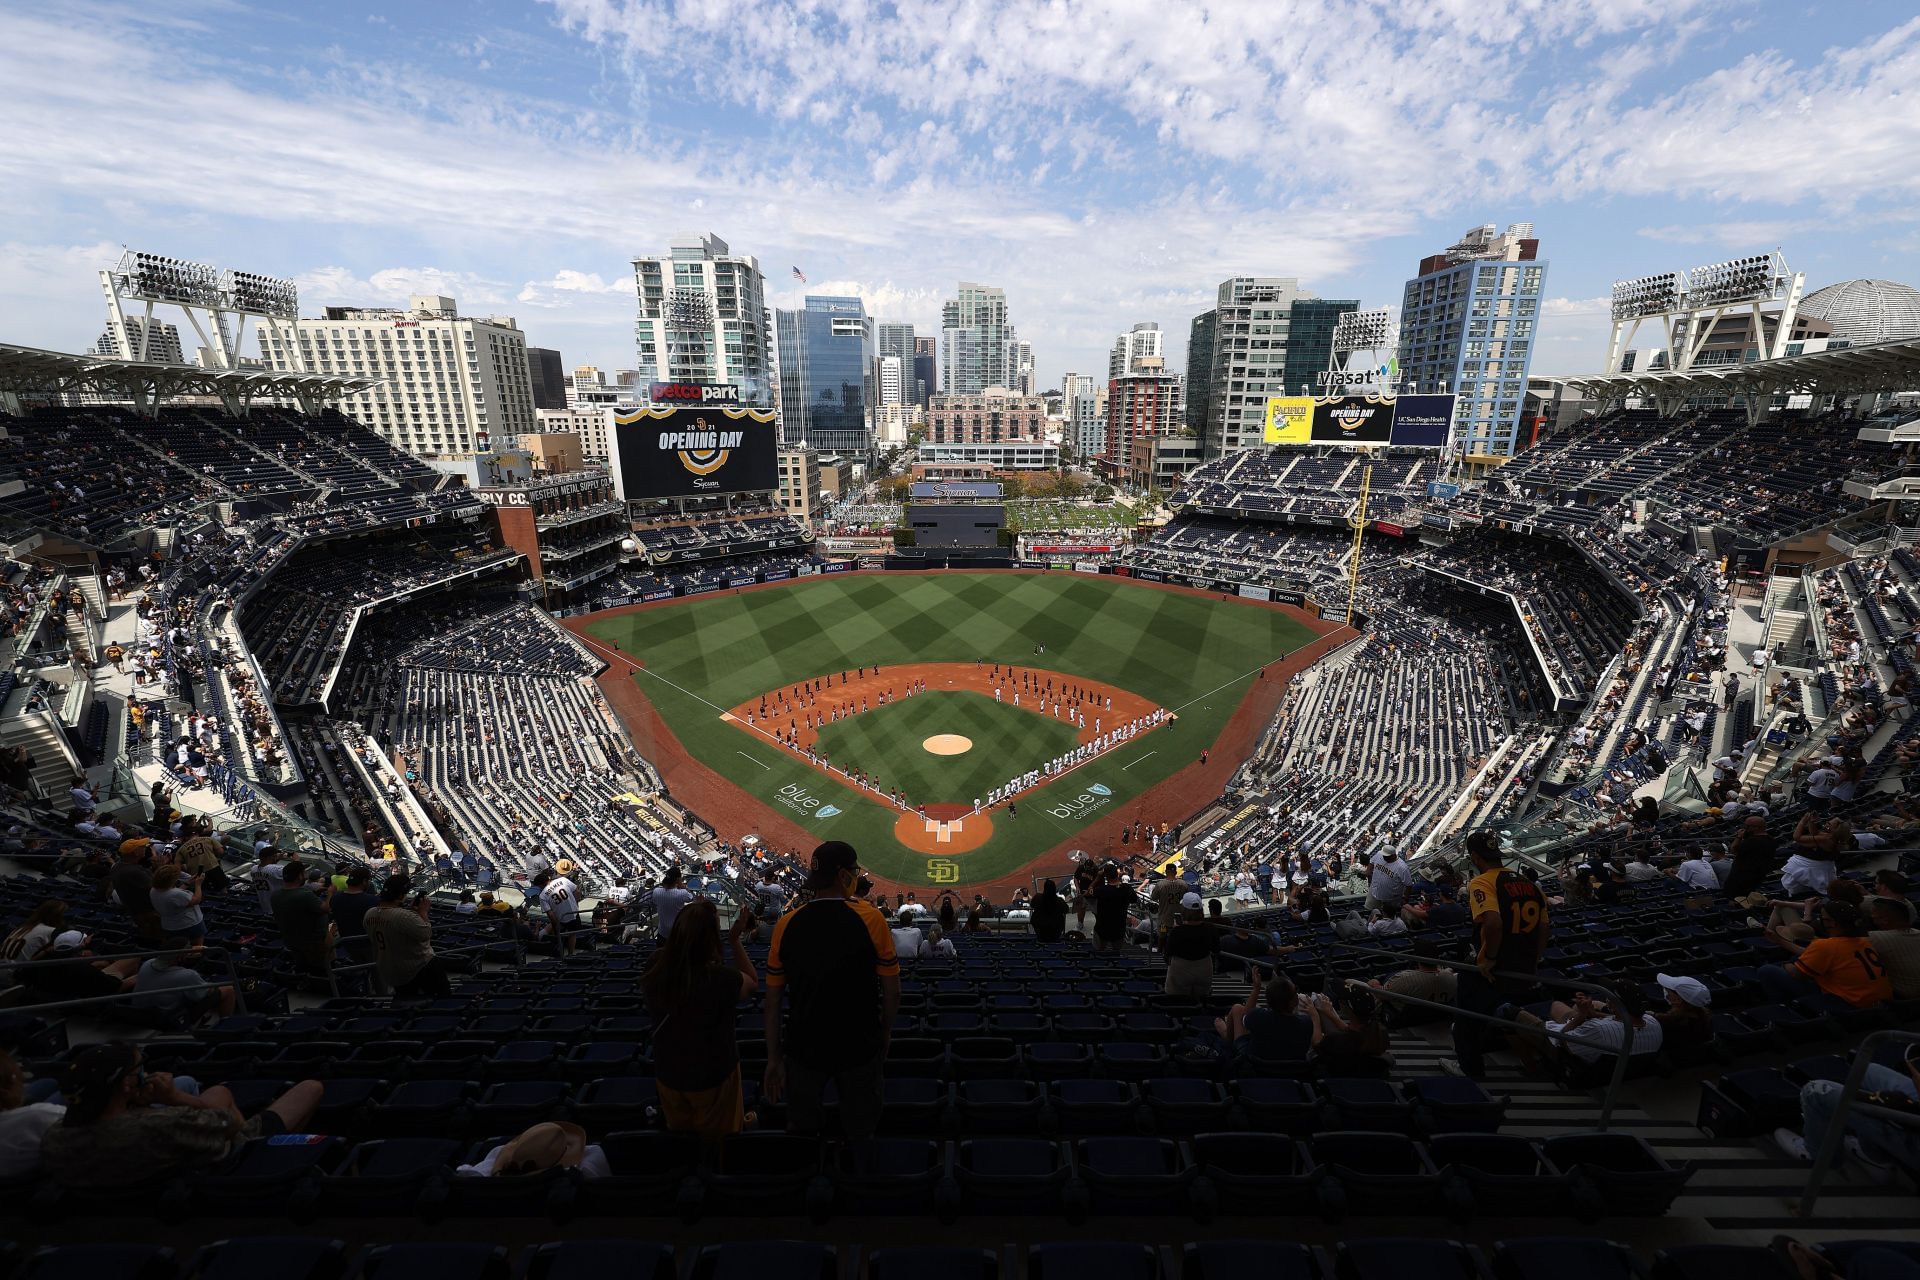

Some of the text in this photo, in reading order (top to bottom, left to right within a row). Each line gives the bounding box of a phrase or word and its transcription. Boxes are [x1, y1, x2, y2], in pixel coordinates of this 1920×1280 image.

[394, 320, 420, 328] Marriott
[1319, 369, 1374, 386] Viasat
[1330, 409, 1376, 417] OPENING DAY
[659, 431, 744, 449] OPENING DAY
[530, 487, 559, 501] WESTERN
[561, 482, 580, 495] METAL
[580, 479, 600, 492] SUPPLY
[693, 478, 720, 489] Sycuan
[730, 577, 755, 586] GEICO
[1140, 572, 1160, 580] Acronis
[686, 584, 719, 594] Qualcomm
[779, 783, 820, 808] blue
[1046, 794, 1095, 818] blue
[186, 842, 205, 858] 23
[1374, 863, 1395, 879] PADRES
[552, 888, 569, 905] 30
[1508, 900, 1540, 934] 19
